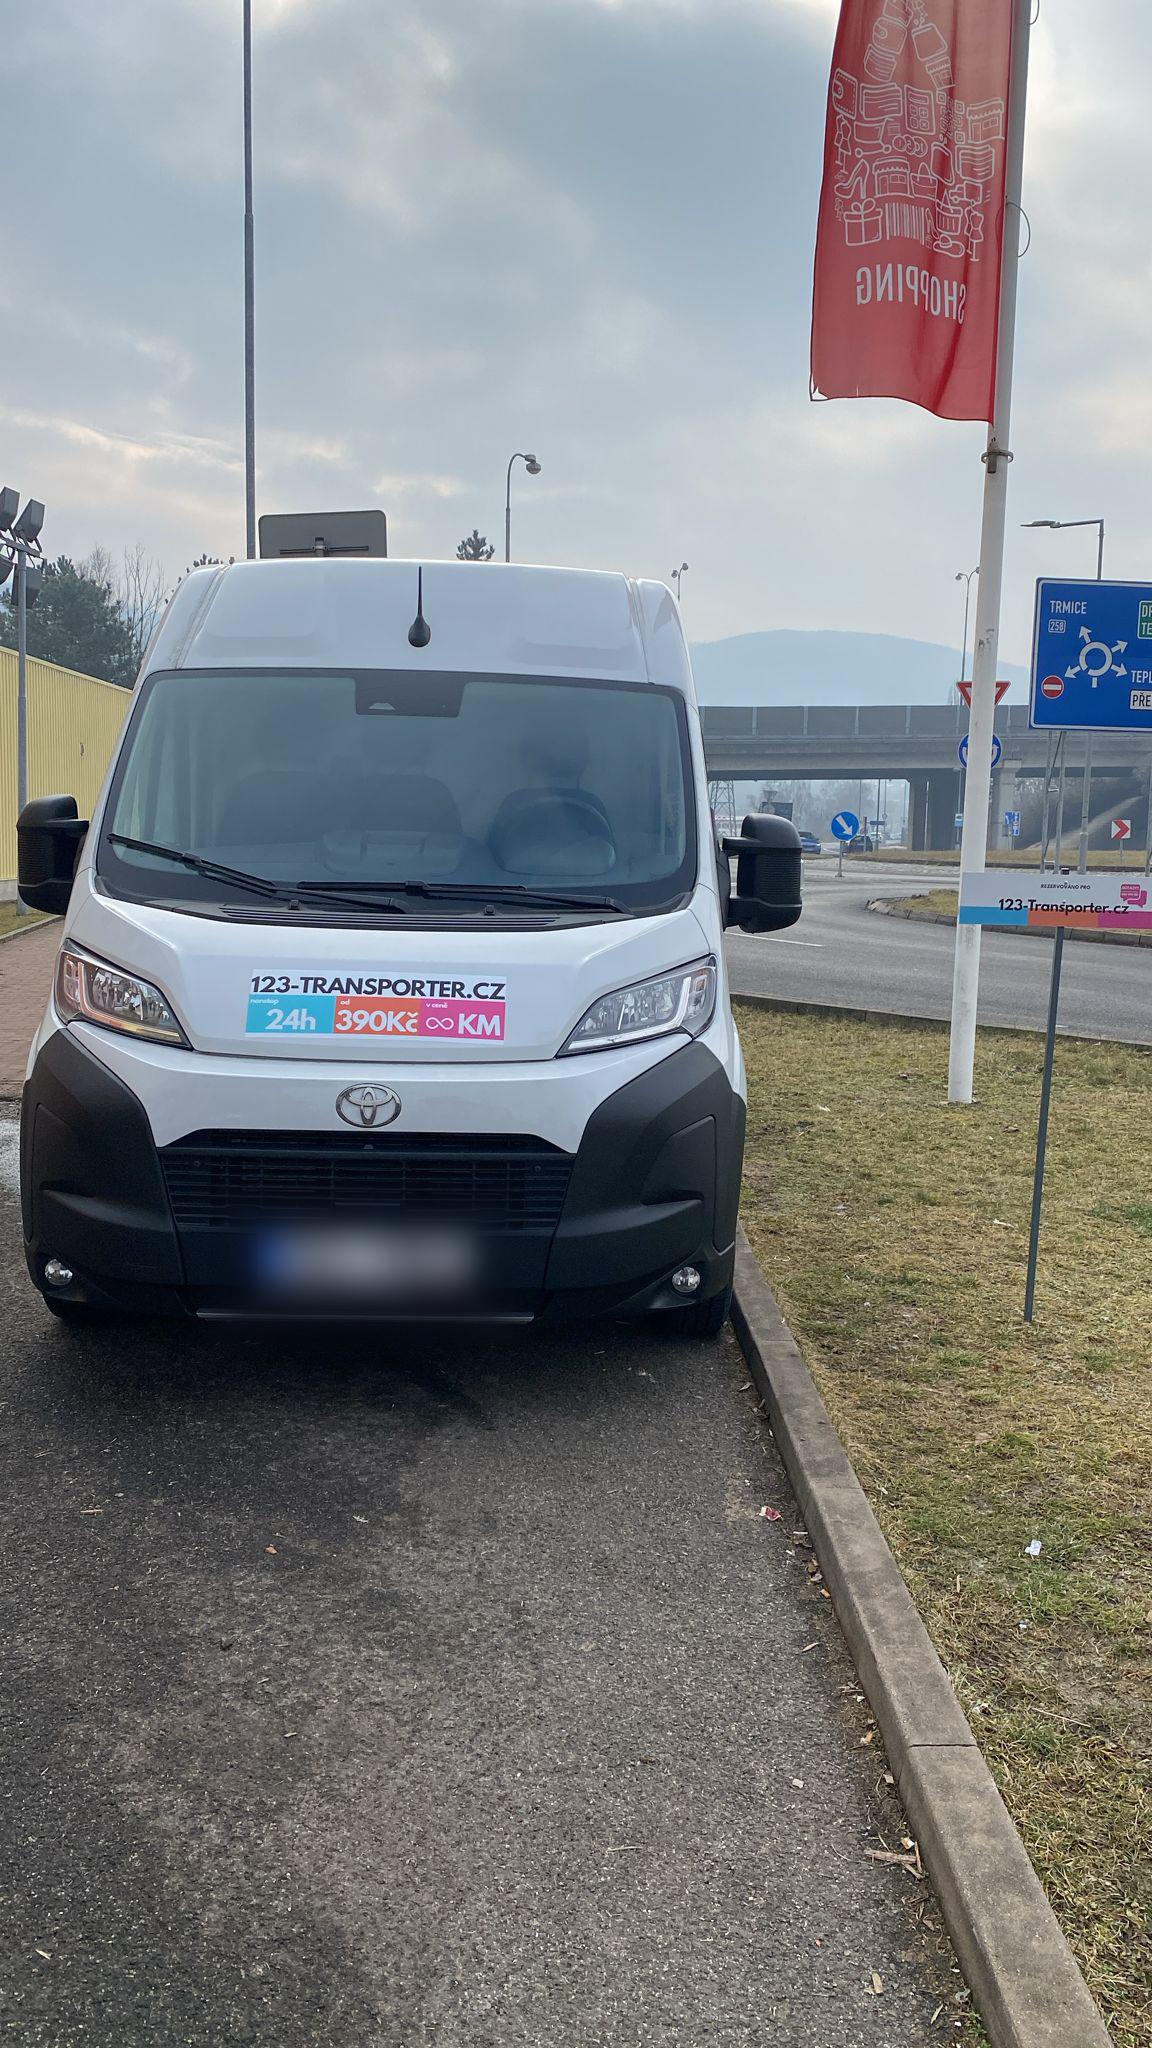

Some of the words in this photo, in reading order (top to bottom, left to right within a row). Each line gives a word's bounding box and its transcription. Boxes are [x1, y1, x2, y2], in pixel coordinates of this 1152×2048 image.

[1050, 600, 1087, 615] TRMICE
[1050, 621, 1064, 632] 258
[1132, 692, 1151, 707] PŘE
[999, 898, 1129, 916] 123-Transporter.cz
[251, 976, 506, 1000] 123-TRANSPORTER.CZ
[265, 1008, 316, 1031] 24h
[336, 1009, 418, 1033] 390Kč
[458, 1013, 501, 1037] KM
